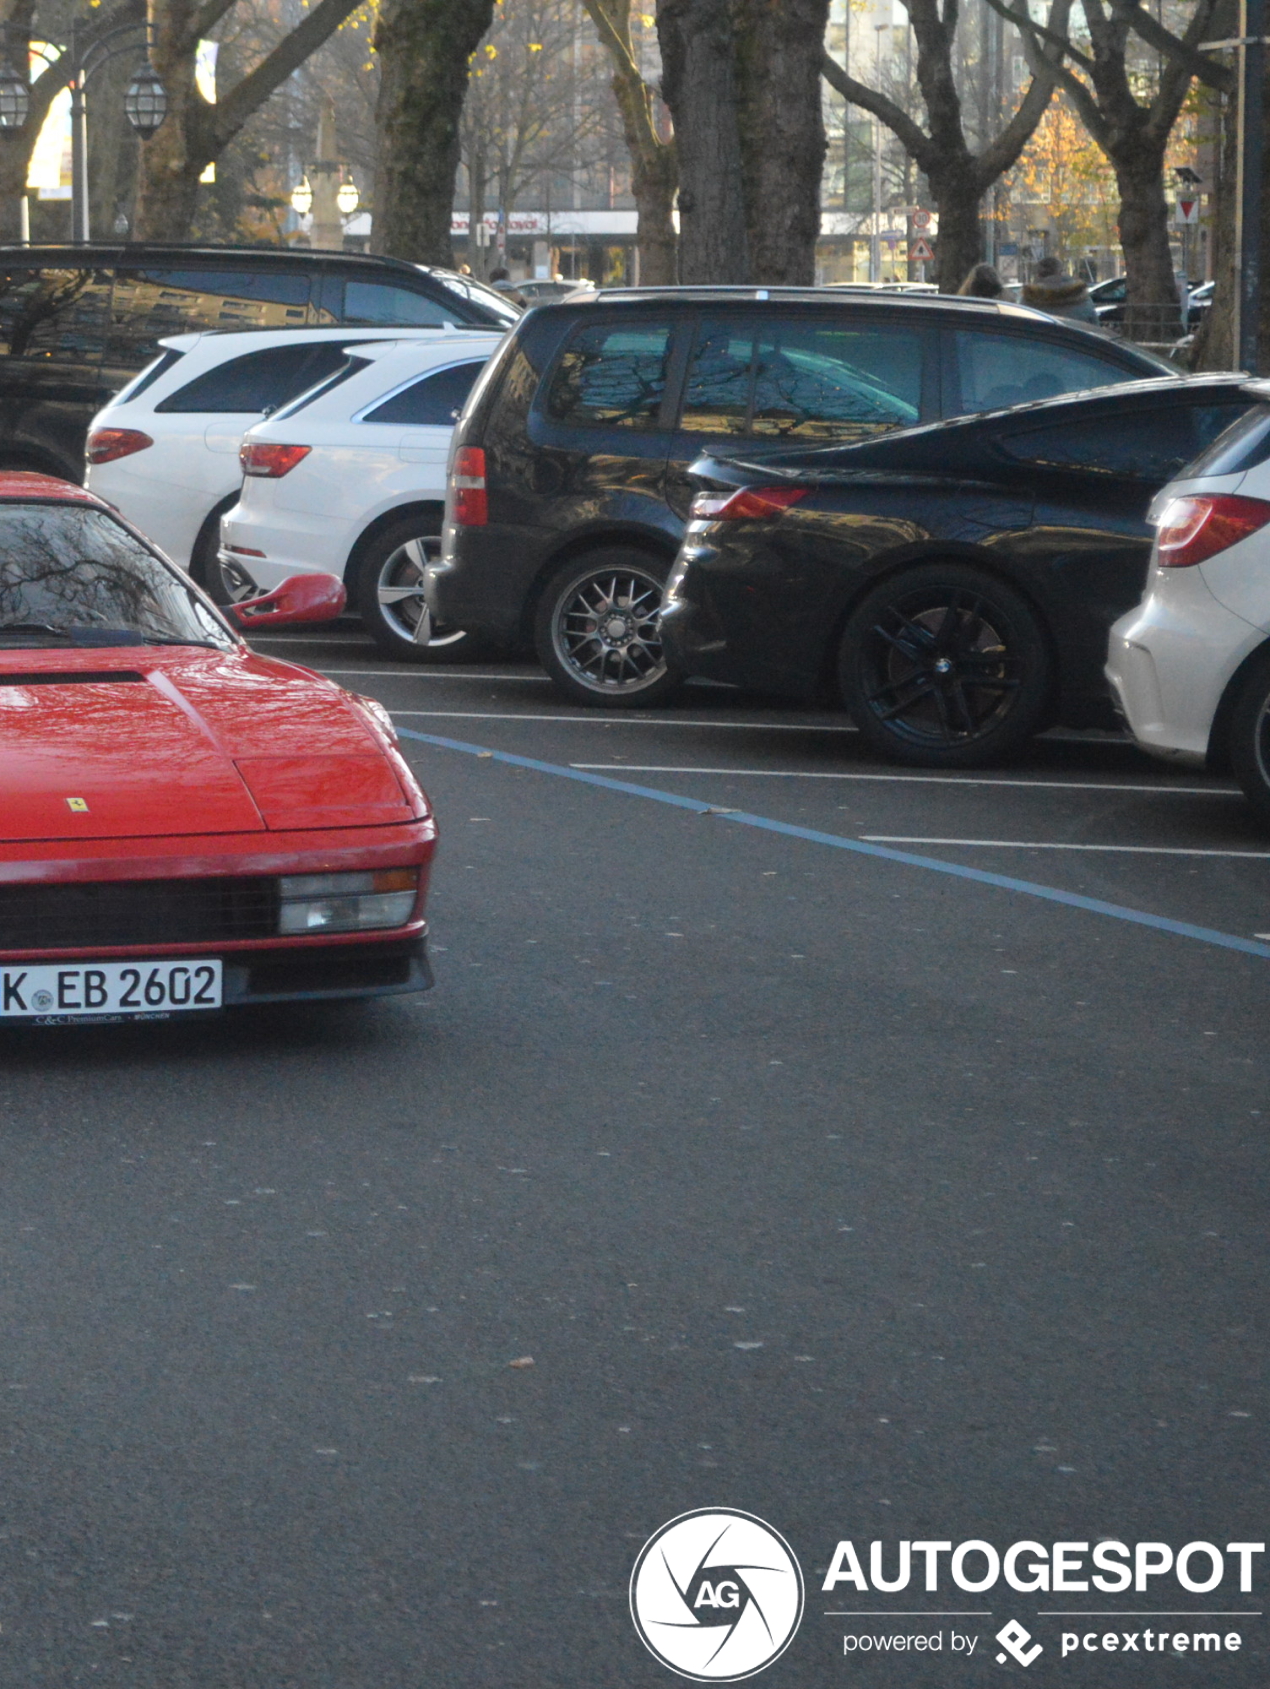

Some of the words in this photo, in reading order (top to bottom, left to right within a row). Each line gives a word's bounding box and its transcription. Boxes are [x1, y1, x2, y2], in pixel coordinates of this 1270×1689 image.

[3, 972, 28, 1011] K
[58, 970, 108, 1009] EB
[119, 966, 216, 1008] 2602
